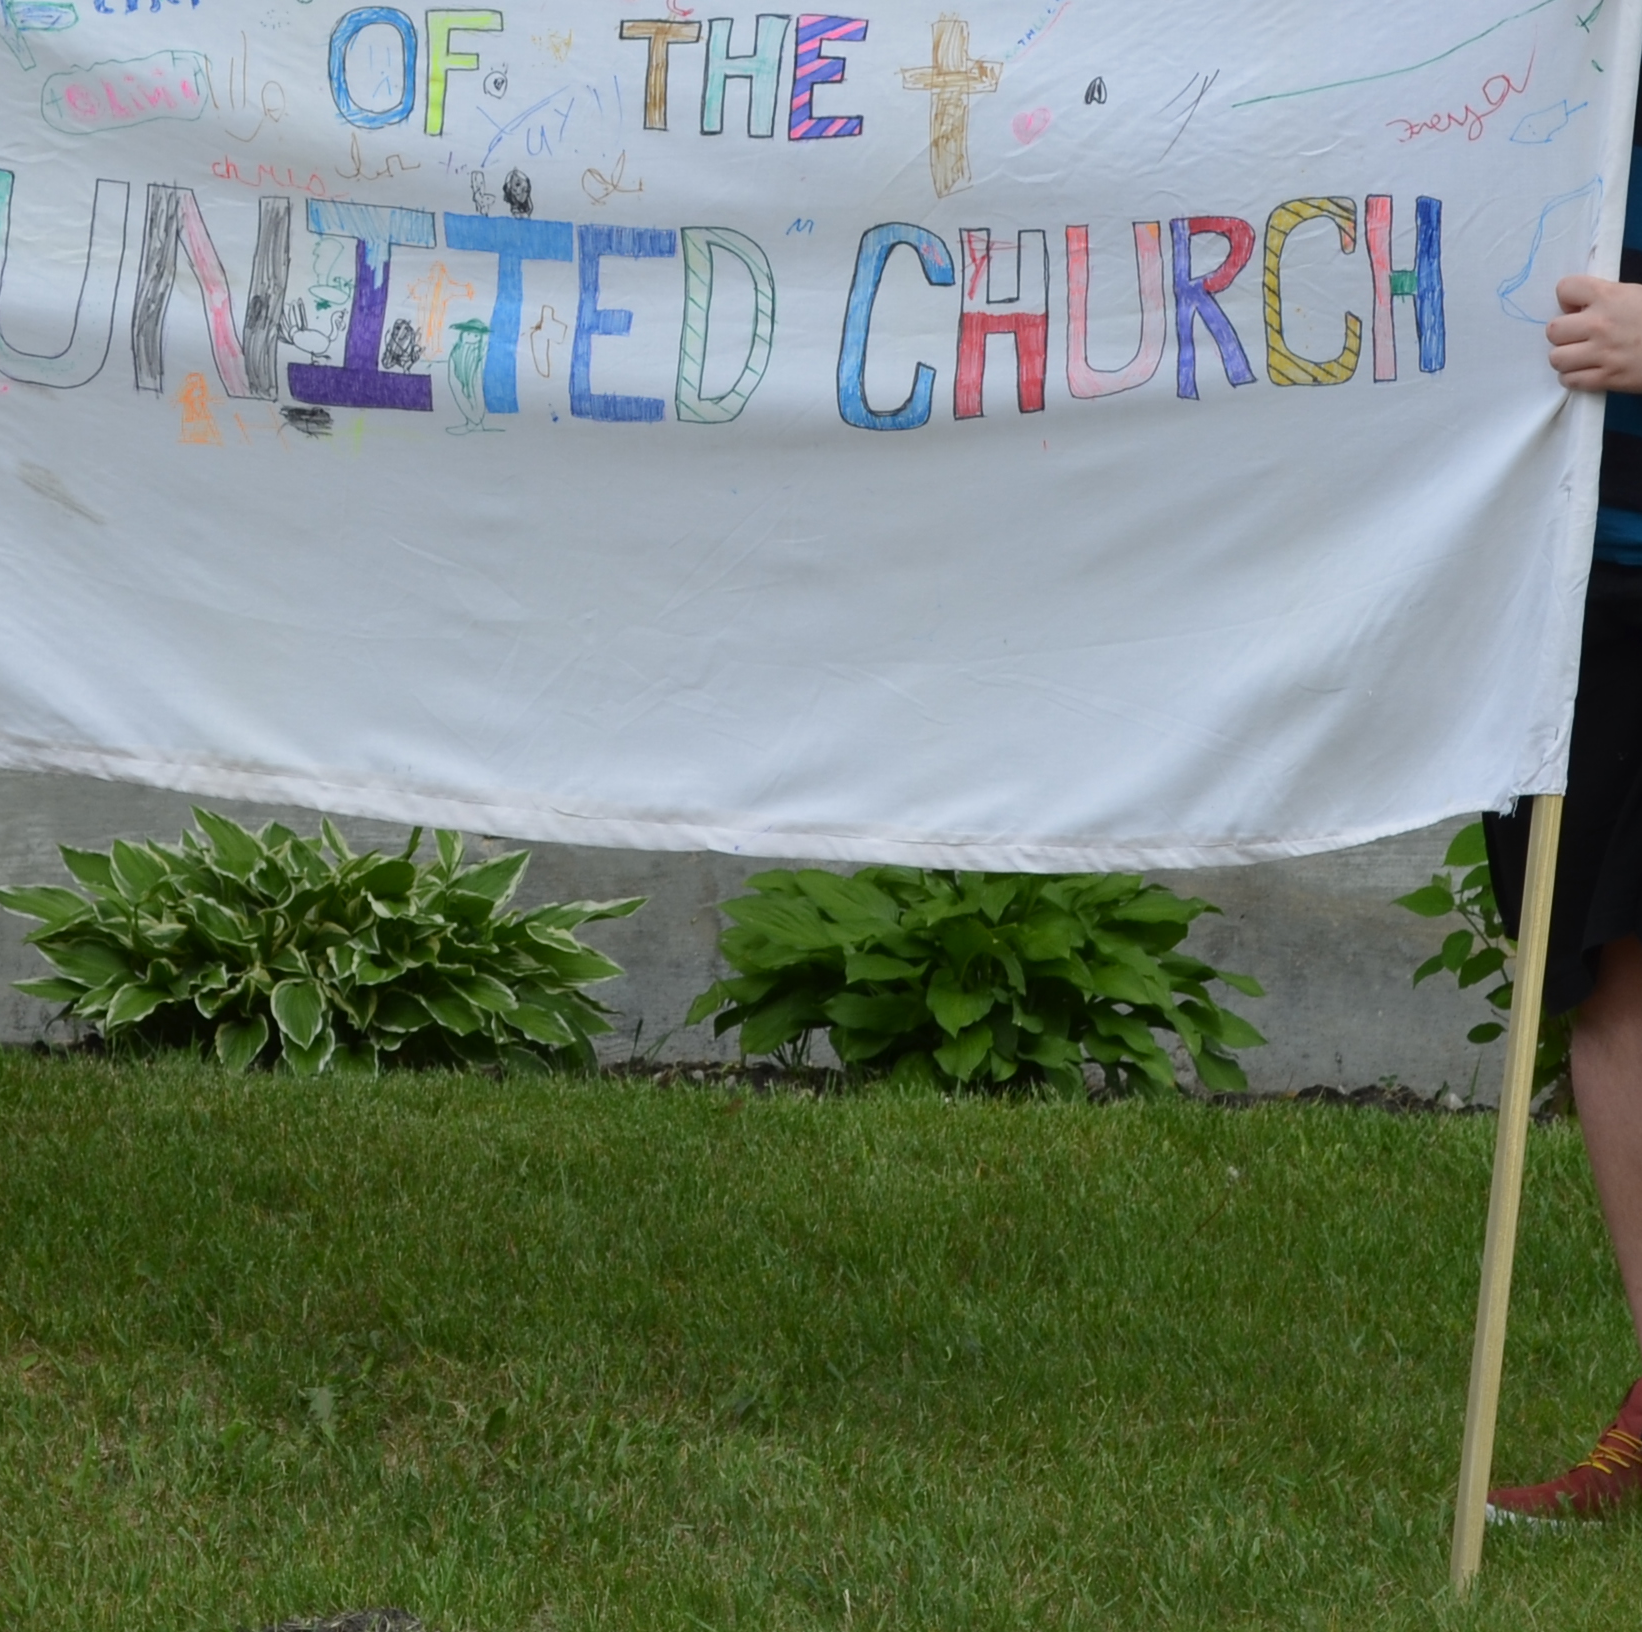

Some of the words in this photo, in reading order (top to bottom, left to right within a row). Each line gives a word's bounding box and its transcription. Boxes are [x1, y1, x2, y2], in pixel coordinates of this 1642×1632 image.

[327, 6, 505, 136] OF
[618, 12, 869, 141] THE
[836, 194, 1446, 431] CHURCH
